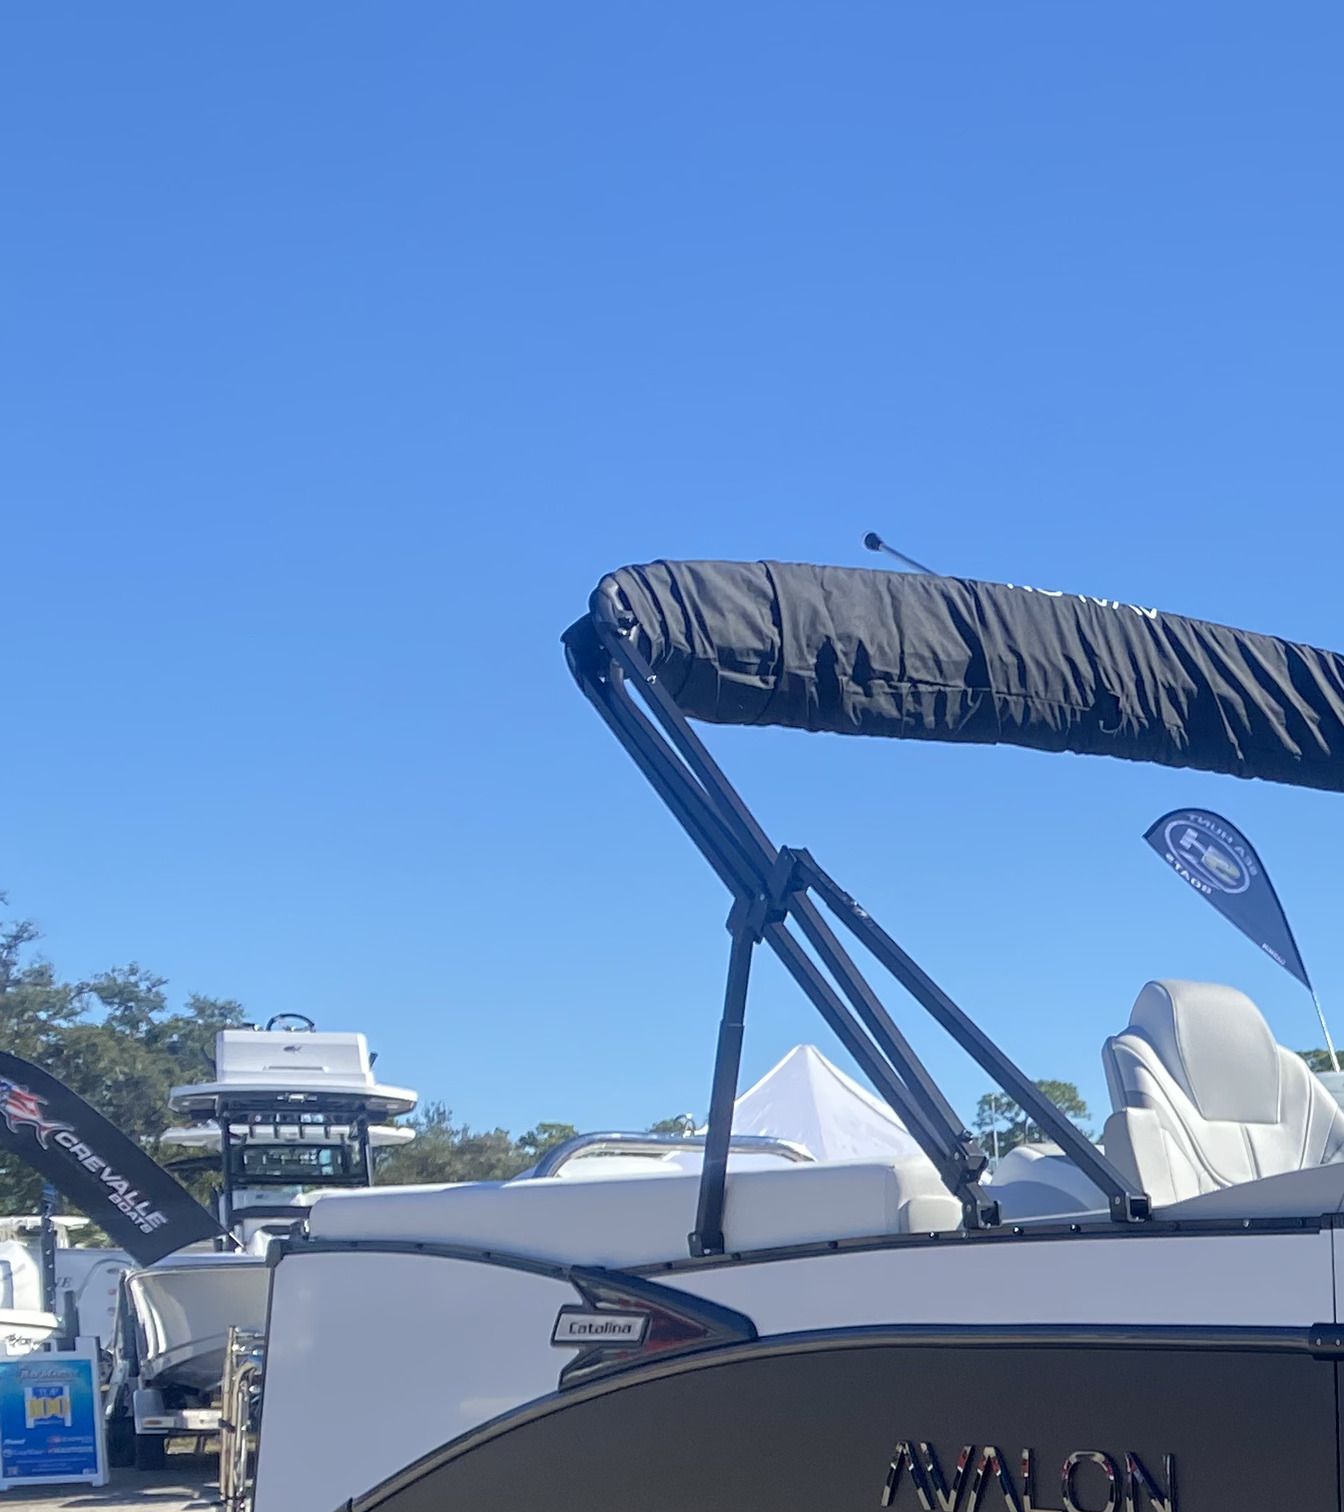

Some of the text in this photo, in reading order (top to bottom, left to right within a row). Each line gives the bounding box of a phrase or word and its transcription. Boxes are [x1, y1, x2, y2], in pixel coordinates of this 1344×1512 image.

[54, 1131, 168, 1230] CREVALLE
[108, 1193, 153, 1234] BOATS
[568, 1321, 632, 1335] Catalina
